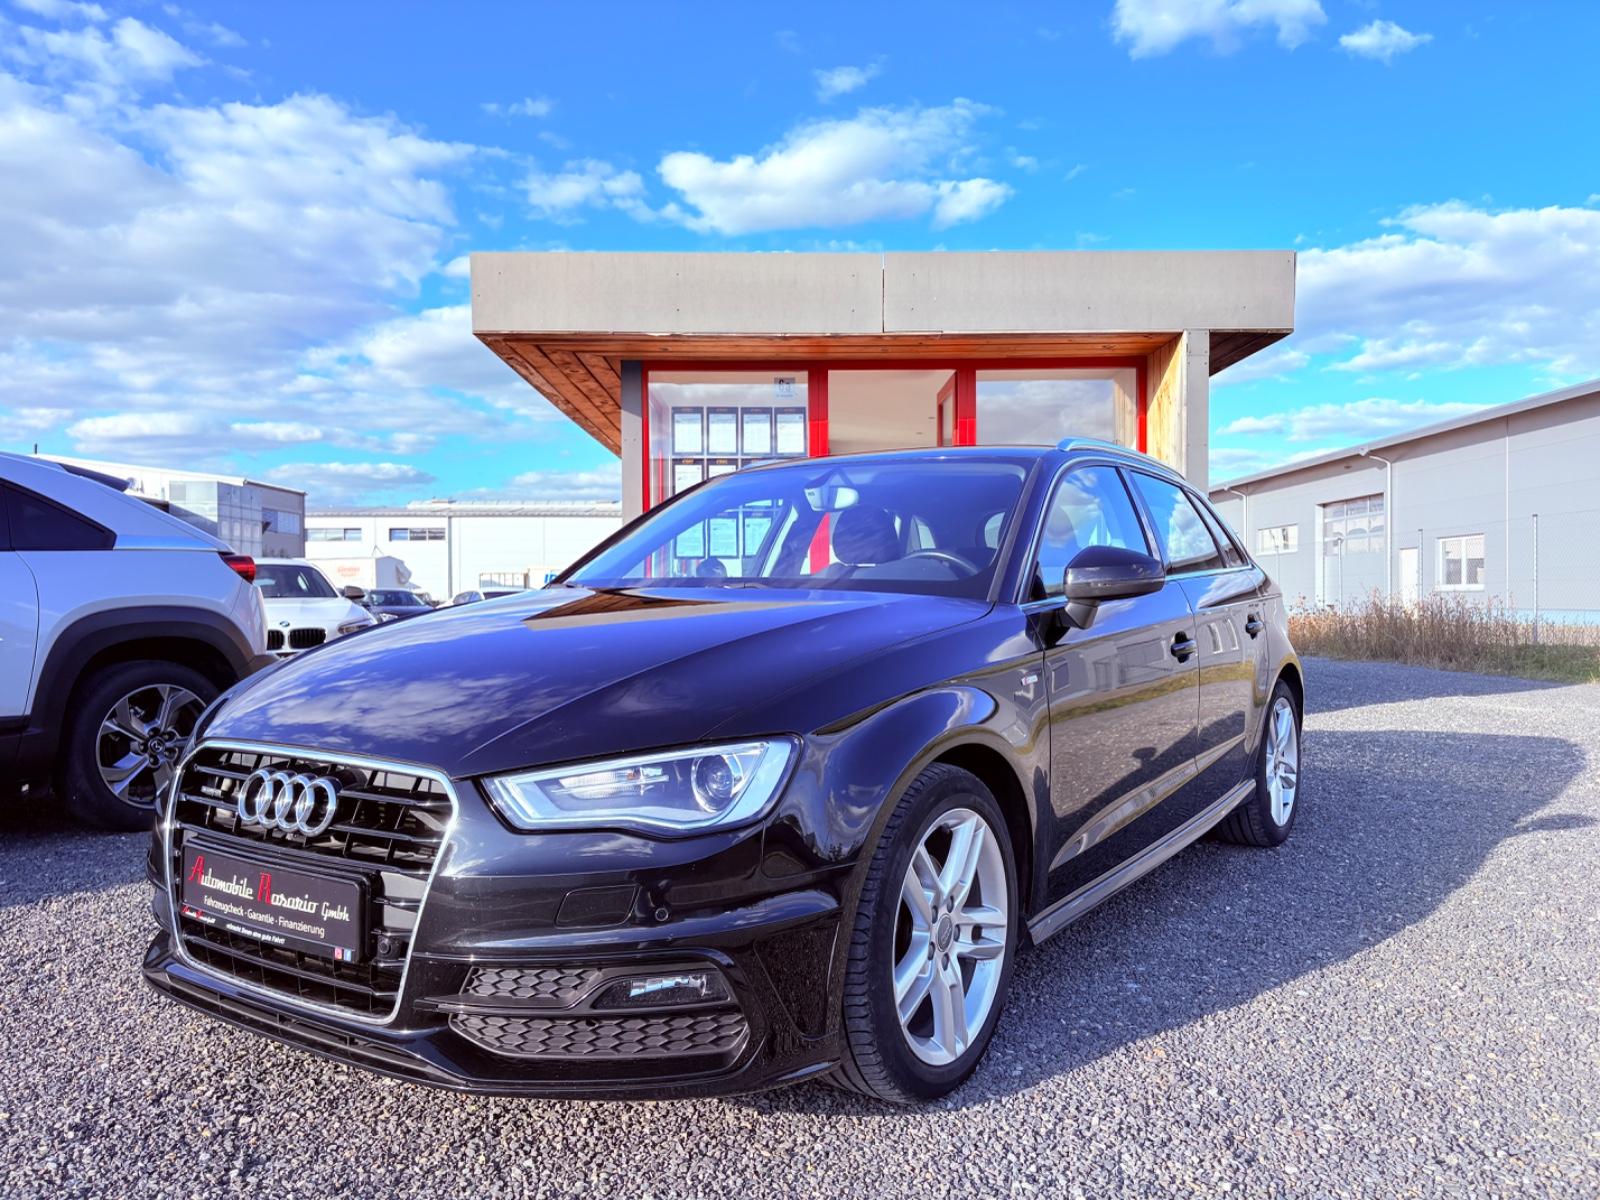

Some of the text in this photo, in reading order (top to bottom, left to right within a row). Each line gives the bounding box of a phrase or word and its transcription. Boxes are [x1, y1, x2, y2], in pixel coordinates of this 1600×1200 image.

[188, 855, 254, 900] Automobile
[257, 872, 319, 914] Rosario
[204, 895, 244, 917] Fahrzeugcheck
[247, 908, 274, 925] Garantie
[278, 915, 325, 939] Finanzierung
